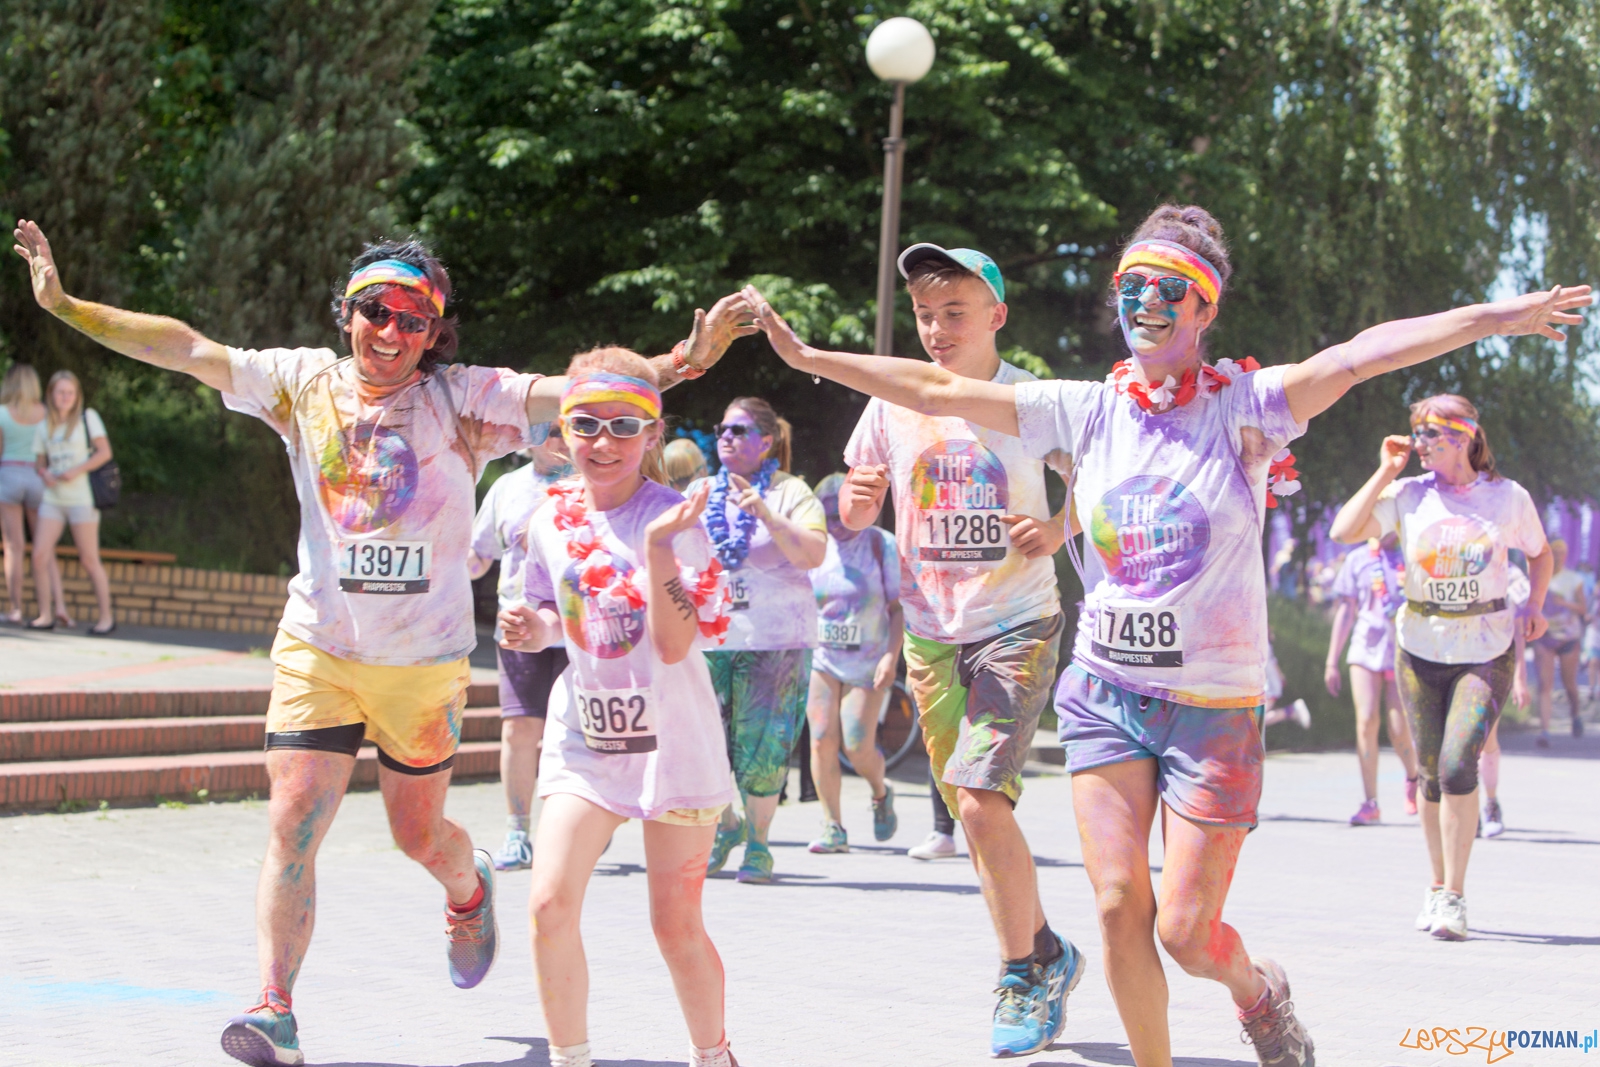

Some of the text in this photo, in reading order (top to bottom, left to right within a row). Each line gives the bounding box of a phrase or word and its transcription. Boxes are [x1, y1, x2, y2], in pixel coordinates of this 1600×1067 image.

[934, 454, 972, 481] THE
[935, 482, 998, 509] COLOR
[1119, 494, 1162, 525] THE
[926, 514, 1001, 545] 11286
[1117, 522, 1195, 556] COLOR
[1440, 524, 1467, 542] THE
[348, 544, 425, 577] 13971
[1436, 541, 1486, 562] COLOR
[1434, 558, 1464, 577] RUN
[663, 576, 693, 621] HAPPY
[1428, 579, 1480, 602] 15249
[587, 618, 625, 647] RUN
[1098, 609, 1176, 648] 17438
[1109, 650, 1153, 664] #HAPPIEST5K
